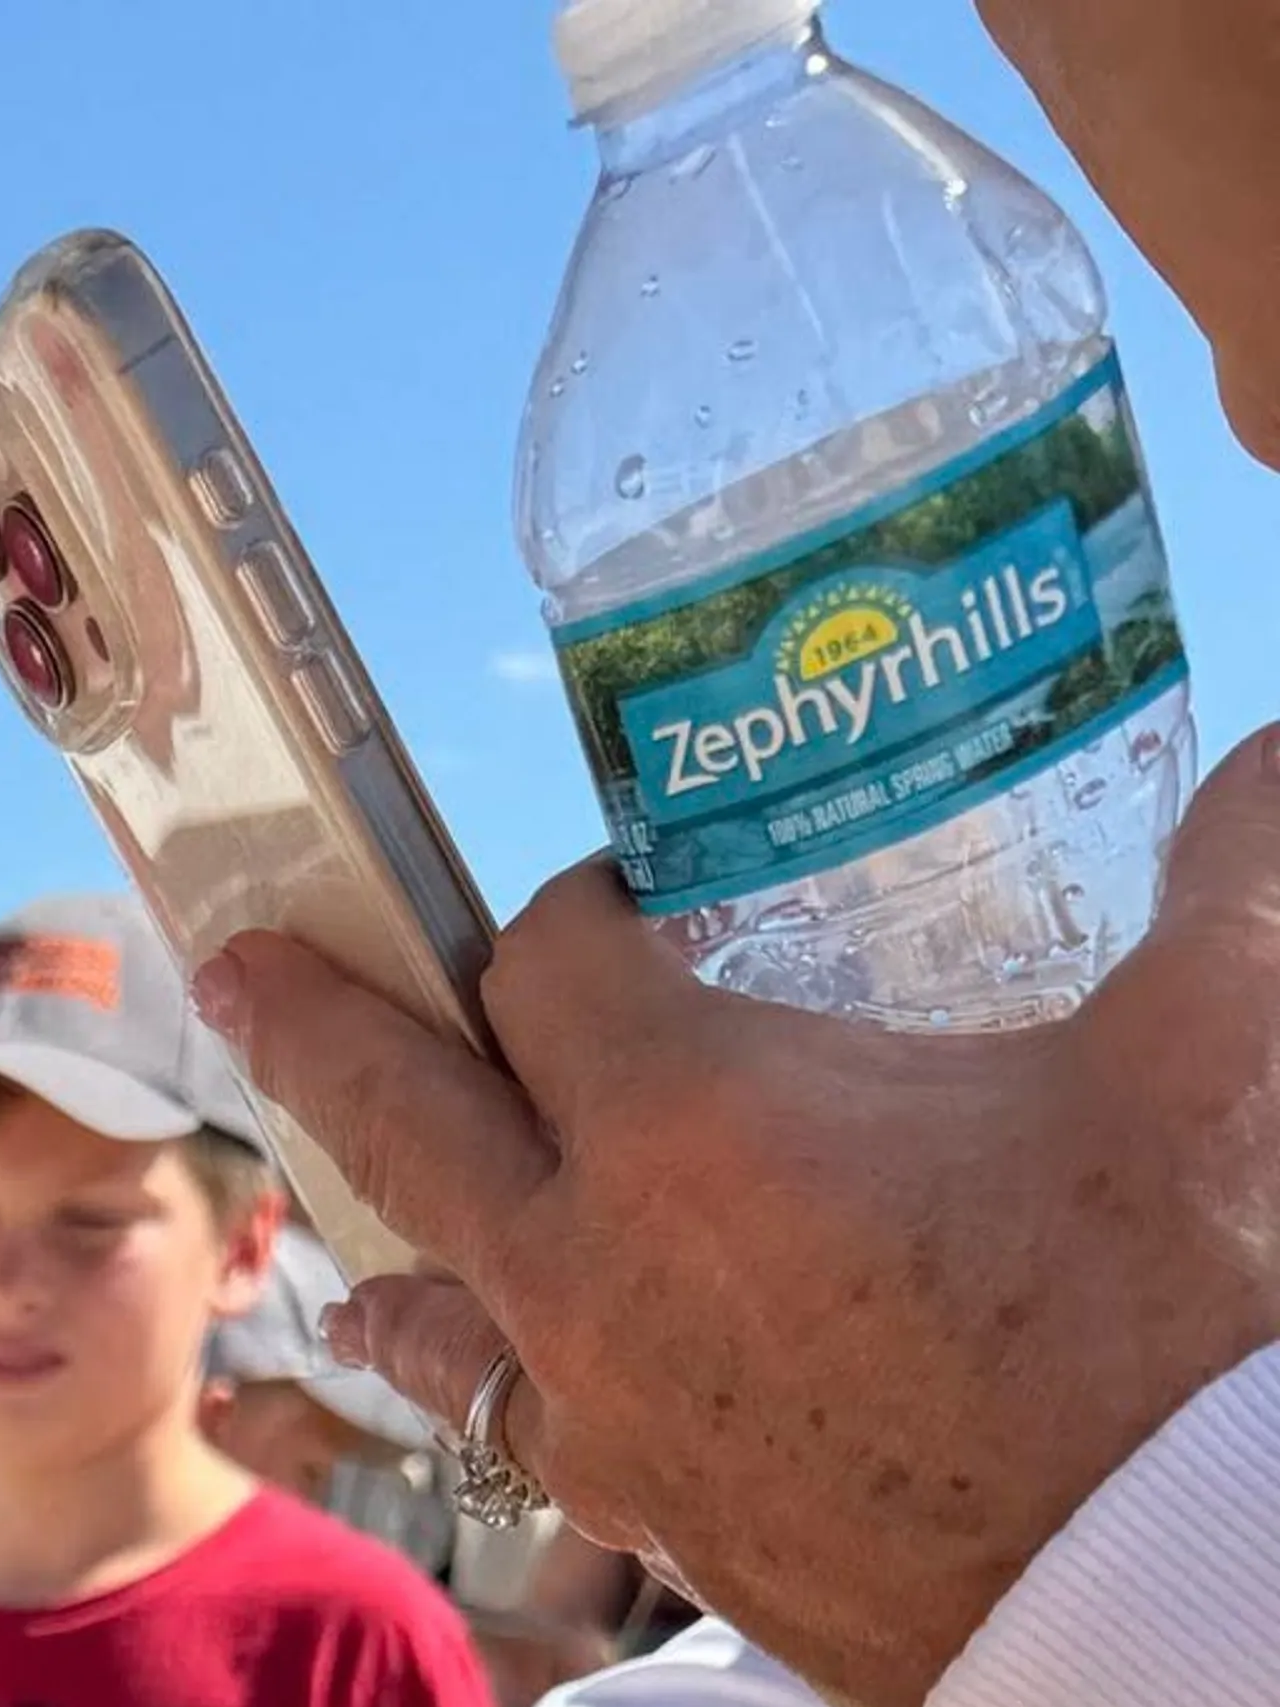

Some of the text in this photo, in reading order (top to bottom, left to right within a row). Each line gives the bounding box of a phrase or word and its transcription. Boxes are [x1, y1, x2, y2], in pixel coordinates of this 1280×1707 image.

[651, 564, 1068, 796] Zephyrhills
[814, 622, 878, 668] 1964
[767, 721, 1014, 847] 100% NATURAL SPRING WATER
